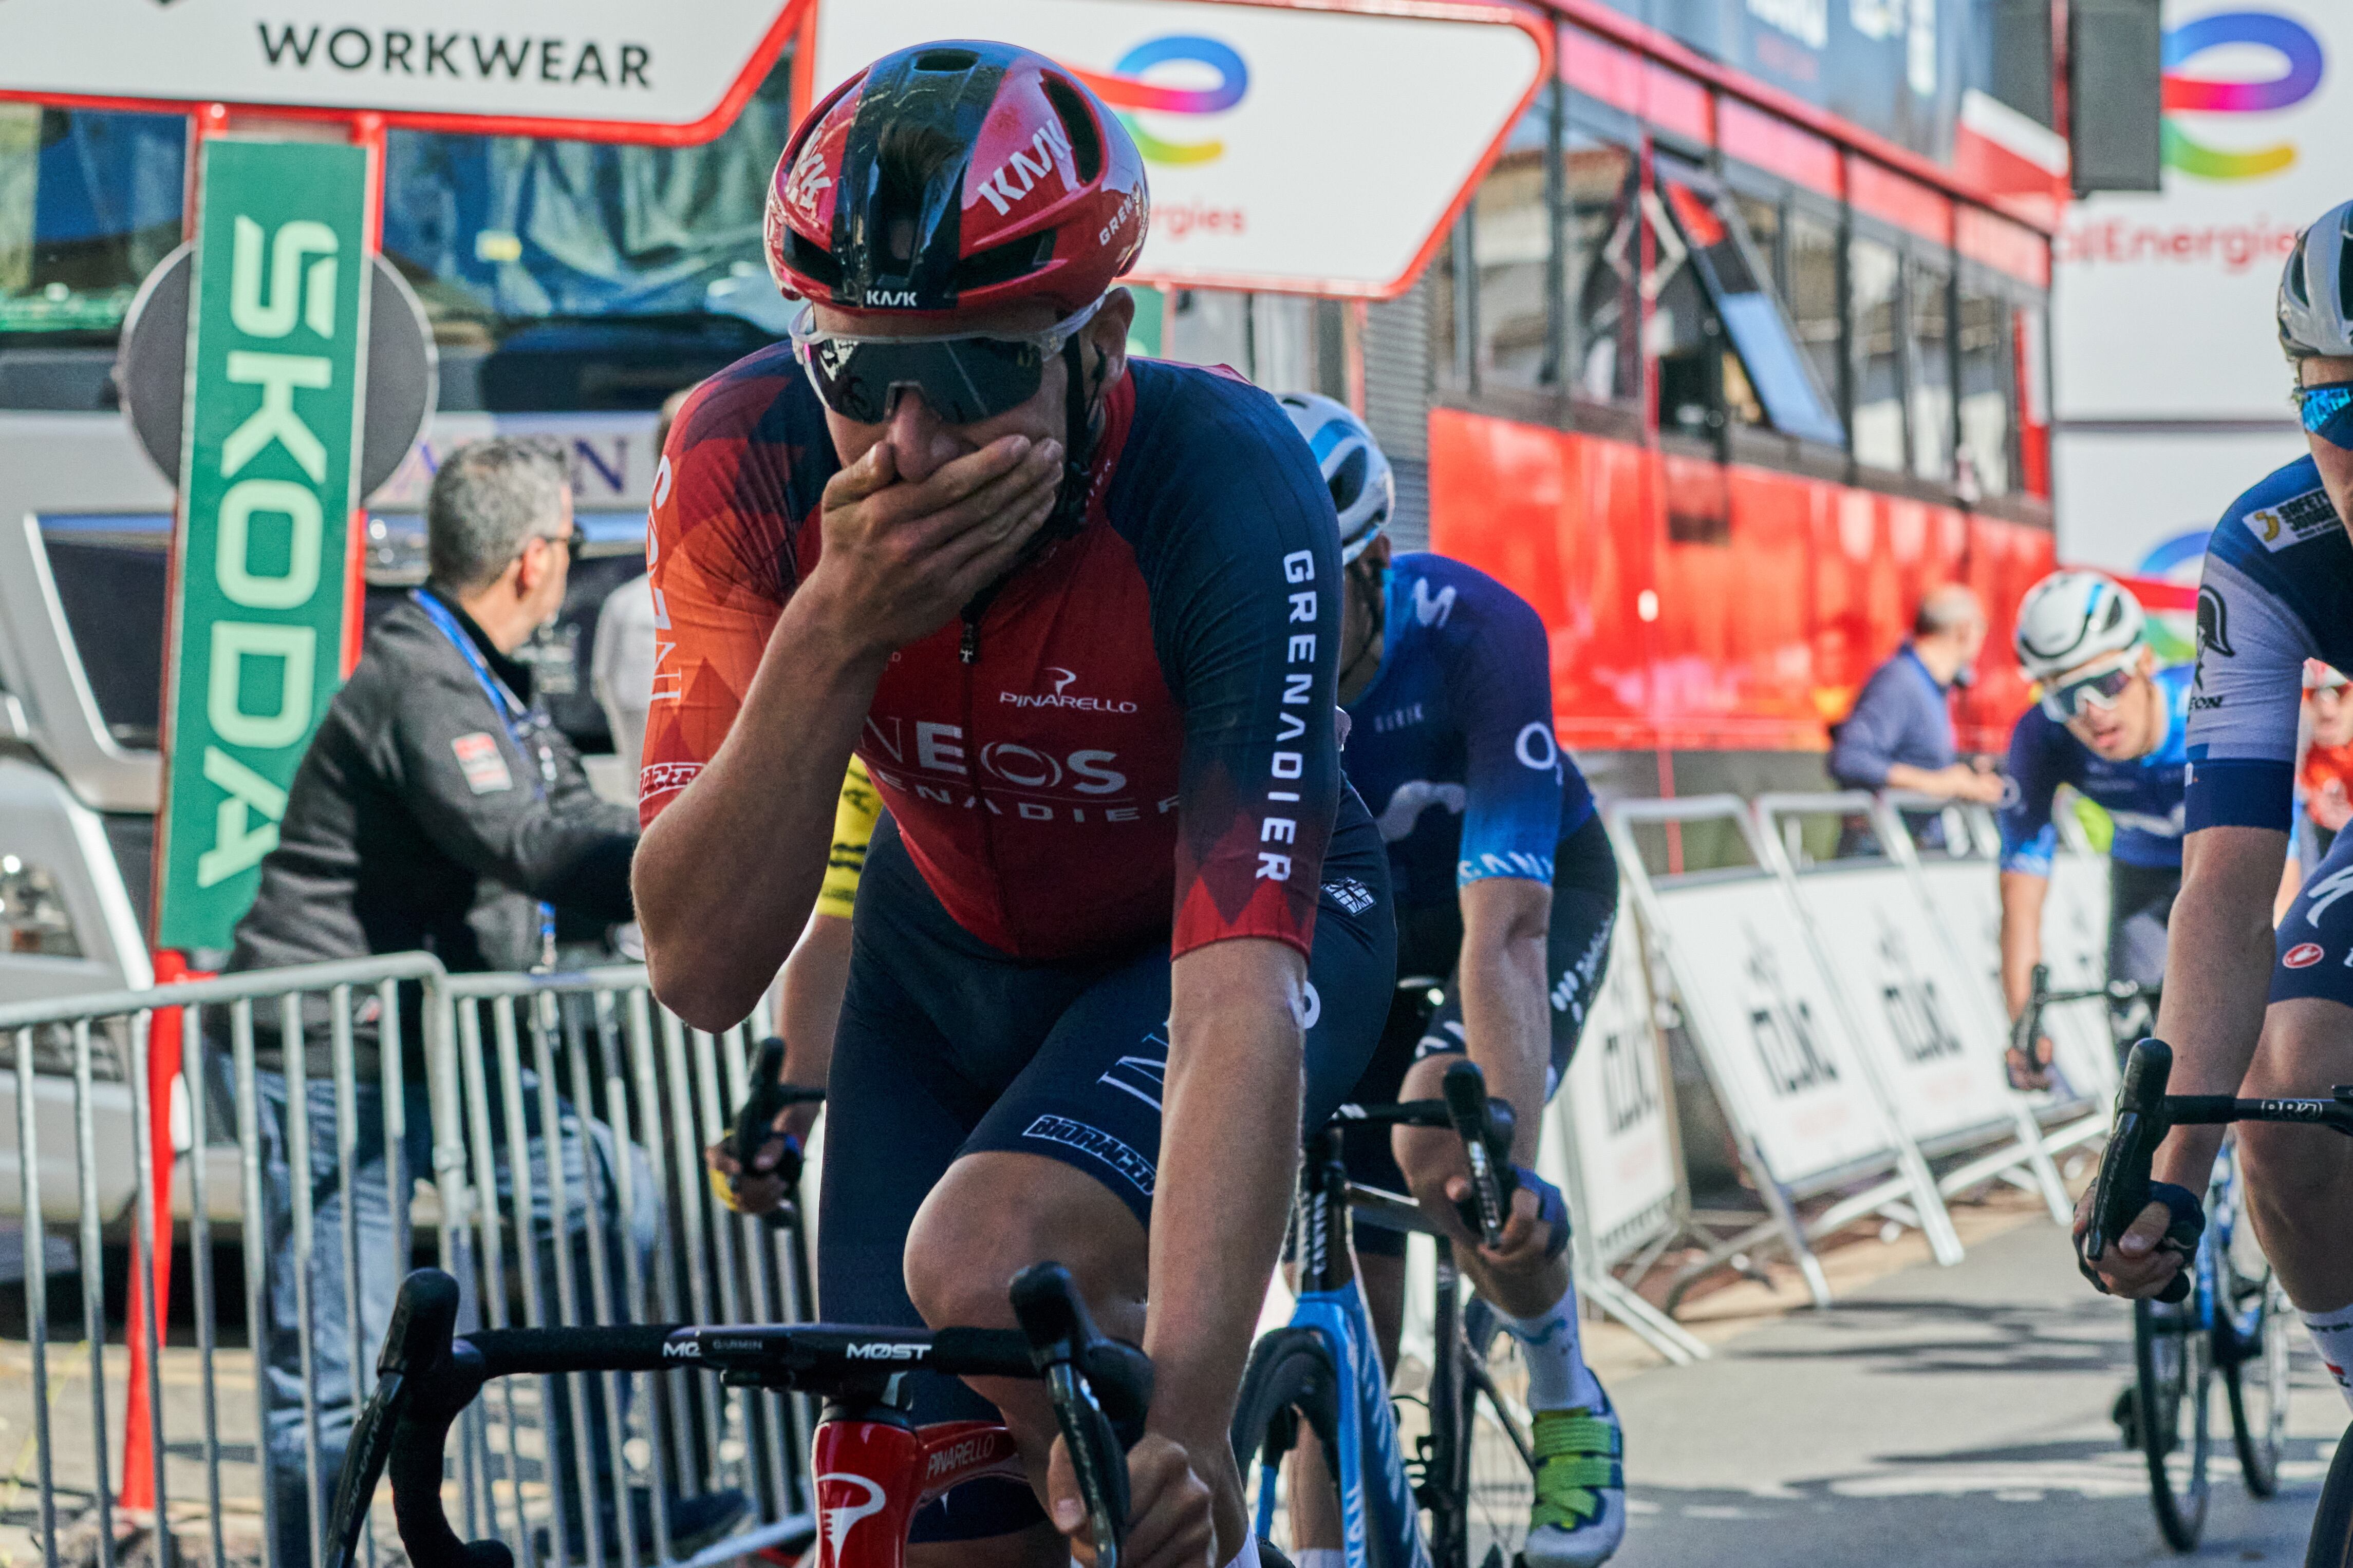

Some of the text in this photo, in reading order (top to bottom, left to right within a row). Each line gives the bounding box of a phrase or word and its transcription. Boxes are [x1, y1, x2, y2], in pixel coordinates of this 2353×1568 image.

[258, 22, 651, 88] WORKWEAR
[978, 119, 1072, 216] KASK
[866, 290, 917, 307] KASK
[1000, 691, 1136, 713] PINARELLO
[1255, 549, 1317, 882] GRENADIER
[713, 1340, 763, 1350] GARMIN
[927, 1433, 995, 1480] PINARELLO
